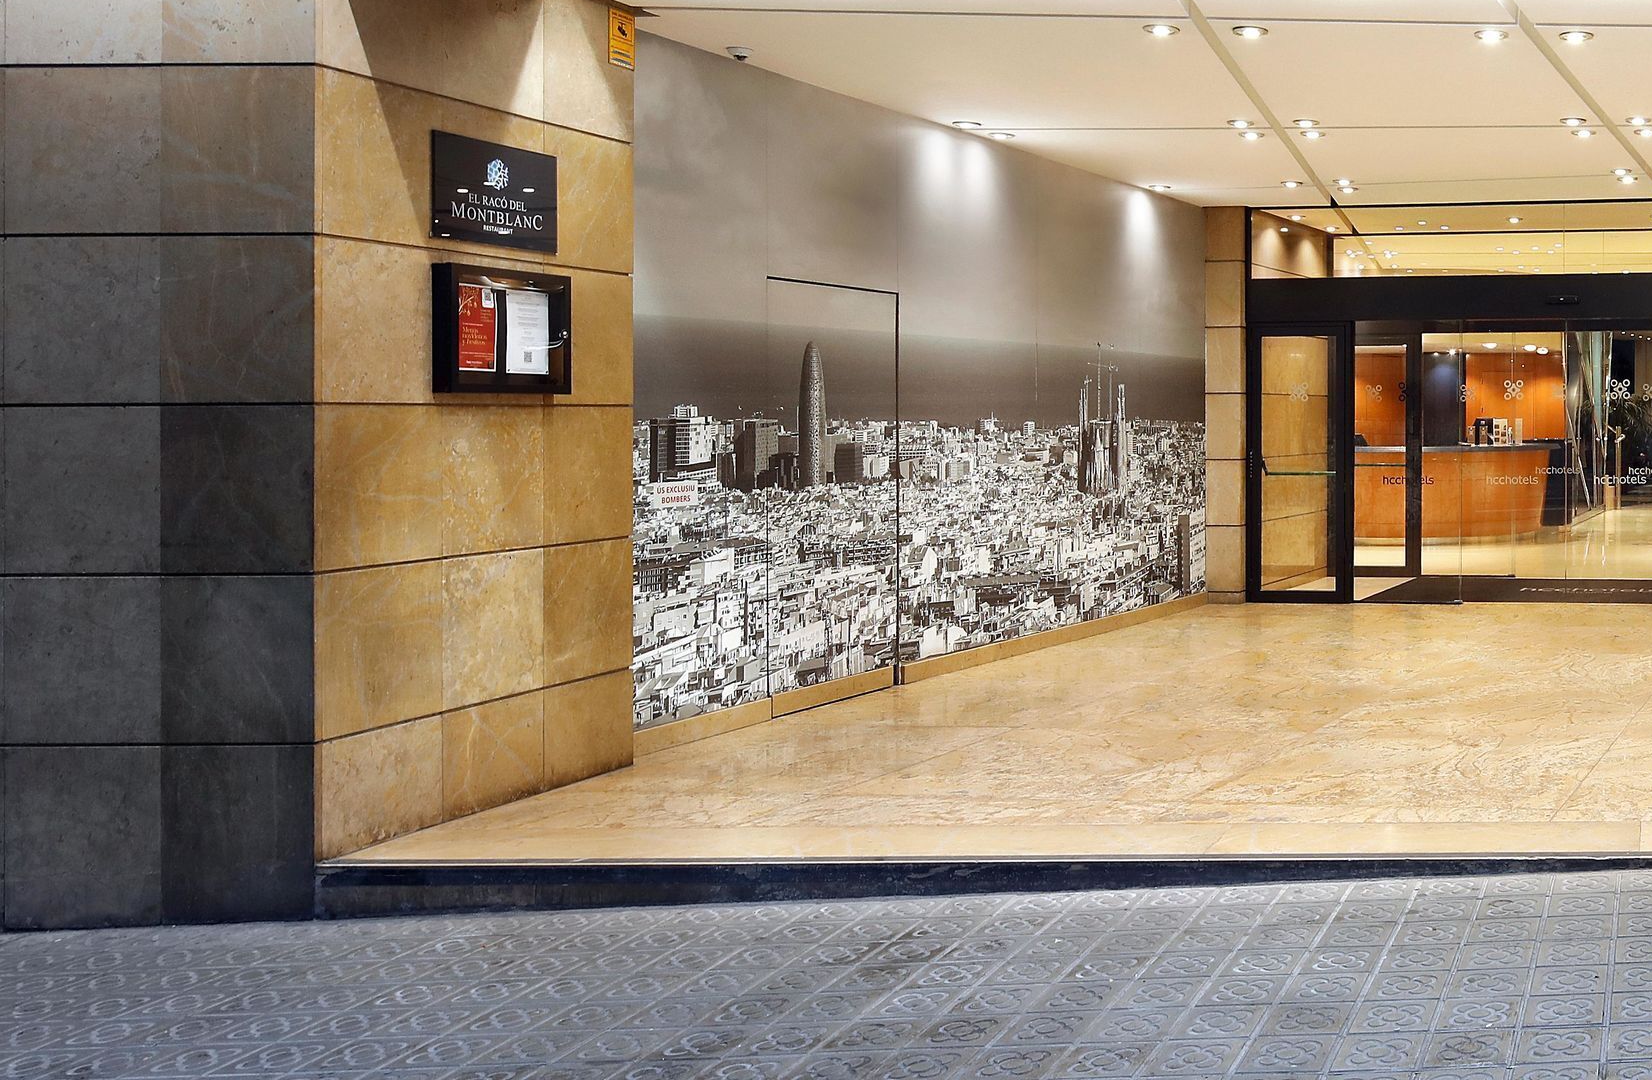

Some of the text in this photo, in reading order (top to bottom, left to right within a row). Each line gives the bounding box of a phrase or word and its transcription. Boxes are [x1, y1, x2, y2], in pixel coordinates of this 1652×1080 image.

[468, 193, 527, 212] EL RACÓ DEL
[451, 201, 543, 230] MONTBLANC
[1535, 466, 1581, 475] hcchotels
[1382, 475, 1435, 485] hcchels
[1486, 475, 1539, 485] hcchotels
[1593, 474, 1647, 485] hcchotels
[666, 484, 696, 494] EXCLUSIU
[661, 495, 691, 504] BOMBERS
